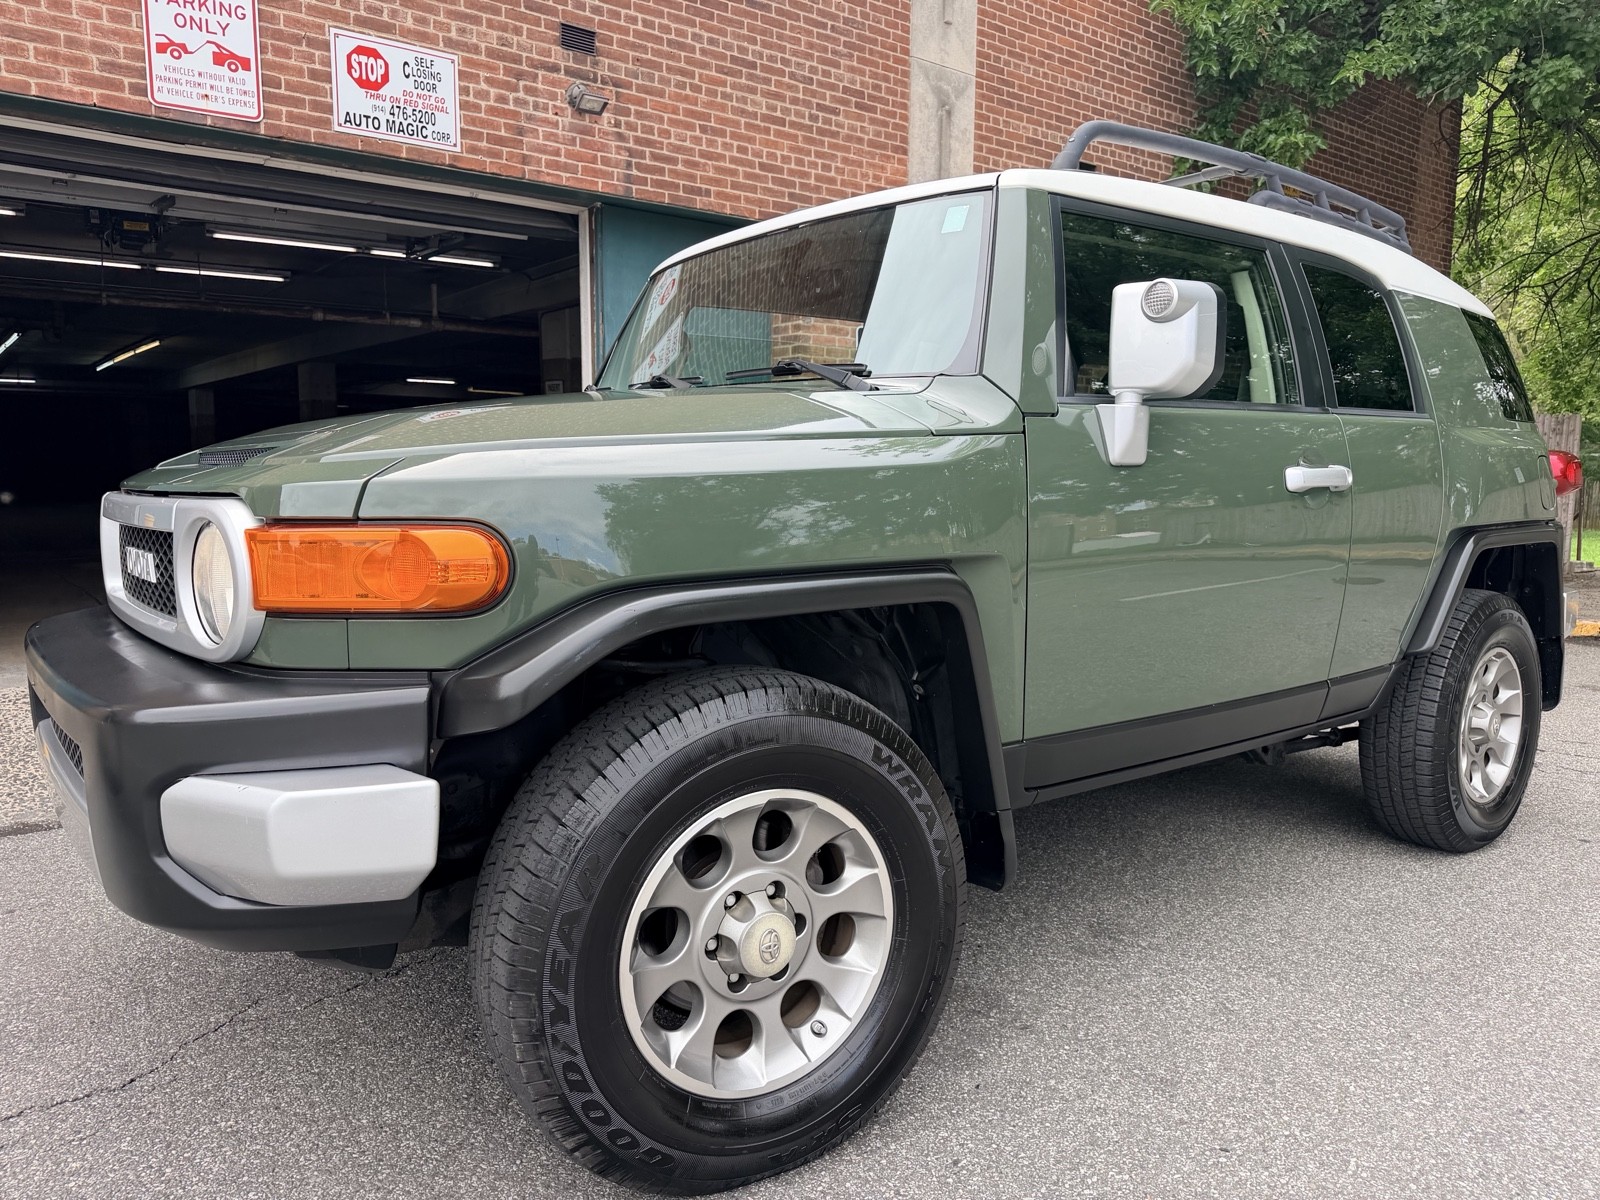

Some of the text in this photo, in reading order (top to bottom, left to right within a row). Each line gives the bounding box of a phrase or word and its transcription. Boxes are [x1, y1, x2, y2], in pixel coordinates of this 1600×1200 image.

[154, 0, 247, 20] ARKING
[173, 12, 231, 37] ONLY
[163, 64, 247, 86] VEHICLES WITHOUT VALID
[350, 53, 386, 83] STOP
[402, 60, 442, 83] CLOSING
[414, 56, 435, 70] SELF
[155, 73, 256, 99] PARKING PERMIT WILL BE TOWED
[156, 85, 165, 94] AT
[166, 87, 195, 100] VEHICLE
[227, 97, 256, 109] EXPENSE
[402, 89, 446, 105] DO NOT GO
[413, 79, 438, 94] DOOR
[364, 90, 450, 115] THRU ON RED SIGNAL
[371, 103, 437, 127] (914) 476-5200
[343, 111, 452, 144] AUTO MAGIC CORP.
[548, 852, 677, 1169] GOODYEAR
